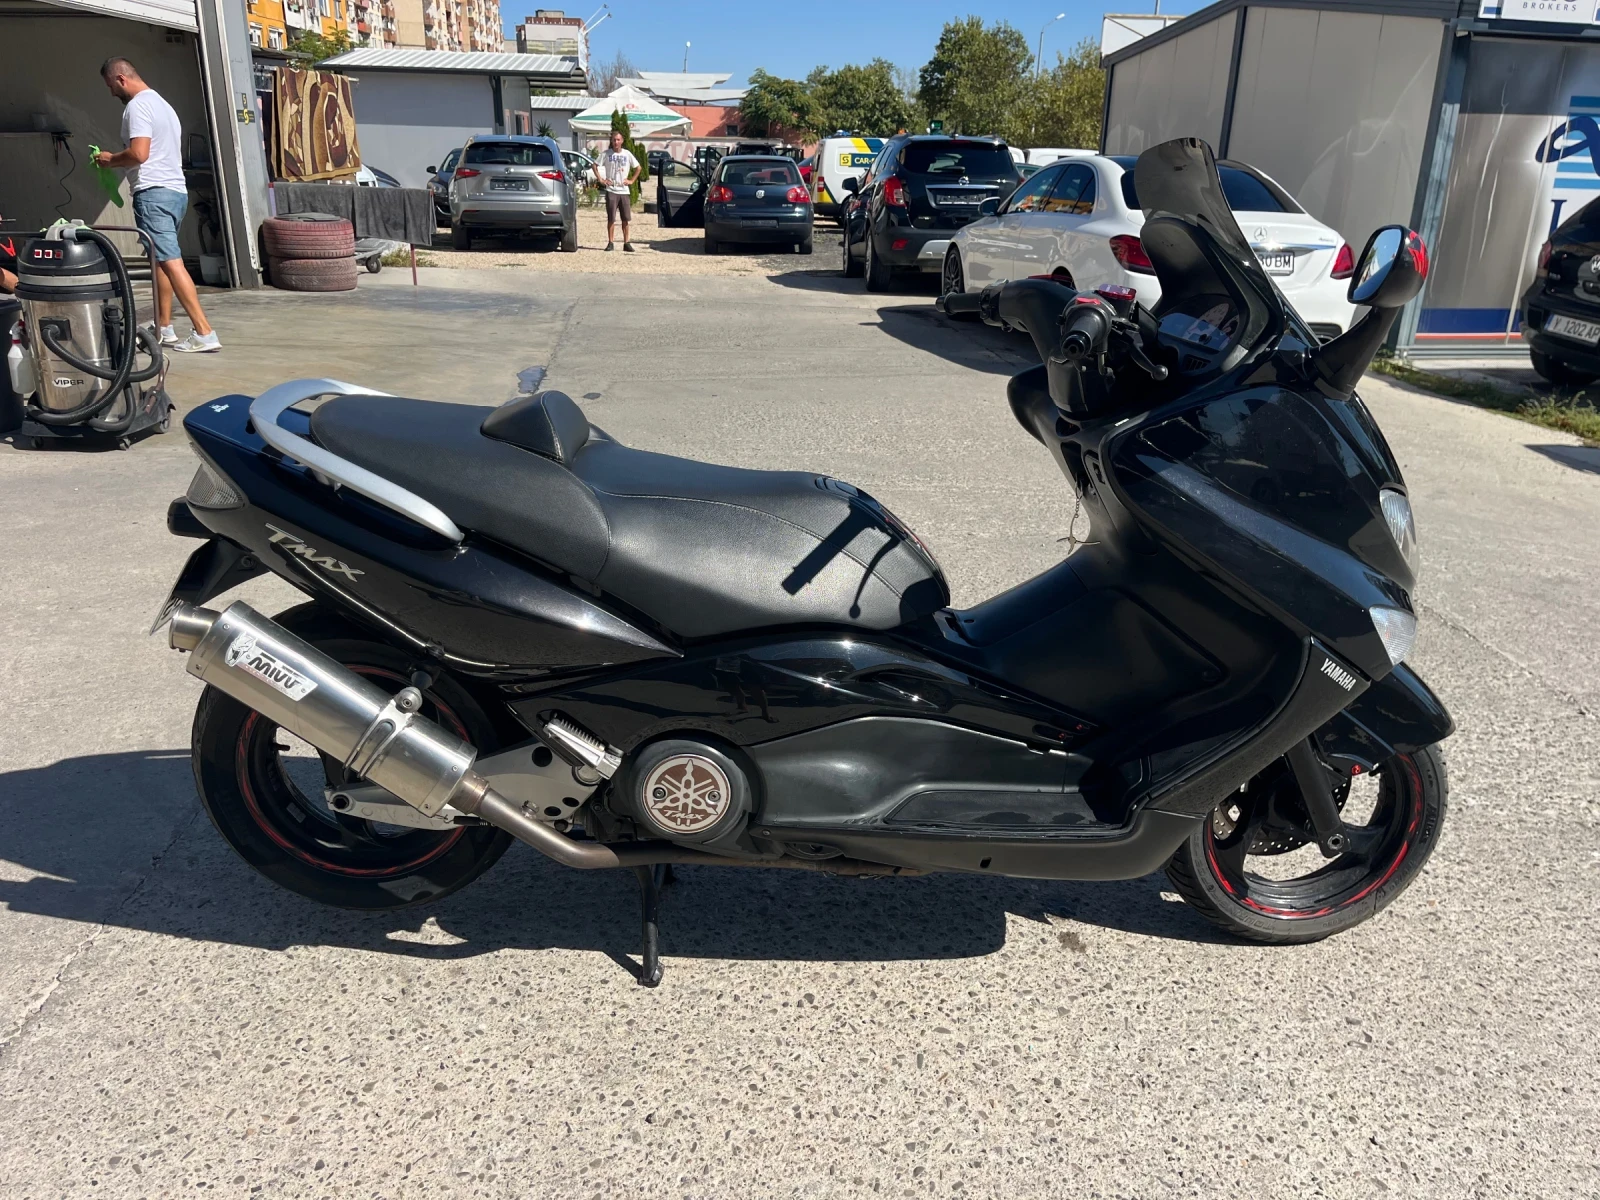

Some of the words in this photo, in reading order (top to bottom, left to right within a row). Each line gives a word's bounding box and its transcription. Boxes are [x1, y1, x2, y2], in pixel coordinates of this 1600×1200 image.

[1522, 2, 1577, 12] BROKERS
[1274, 254, 1291, 268] BM
[1563, 320, 1587, 337] 1202
[247, 652, 303, 690] MIVV
[1320, 657, 1357, 692] YAMAHA
